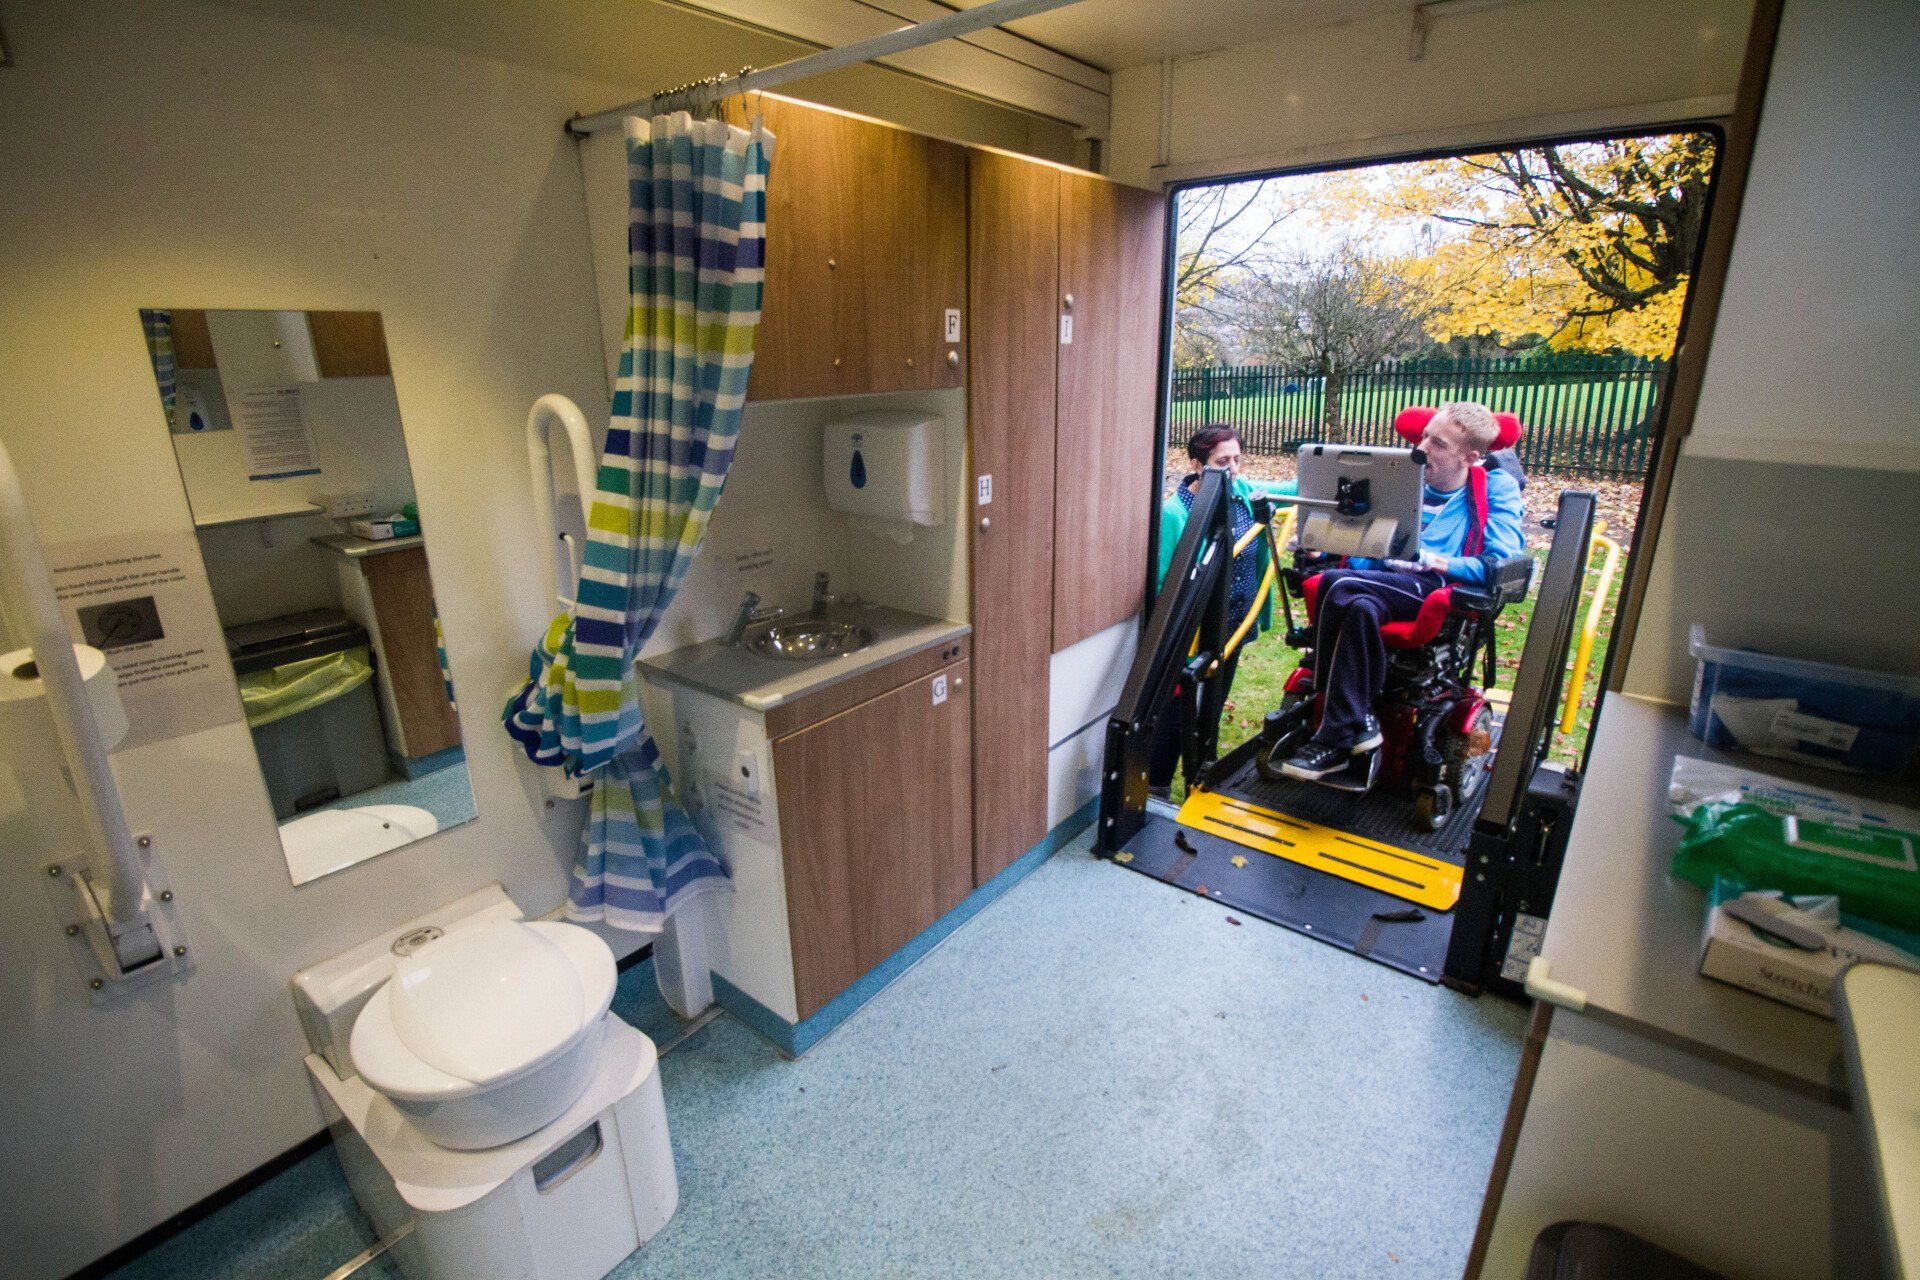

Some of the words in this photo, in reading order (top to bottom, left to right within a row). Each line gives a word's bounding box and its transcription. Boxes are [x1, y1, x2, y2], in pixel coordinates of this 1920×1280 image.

[947, 314, 958, 335] F
[979, 478, 990, 497] H
[934, 679, 945, 698] G
